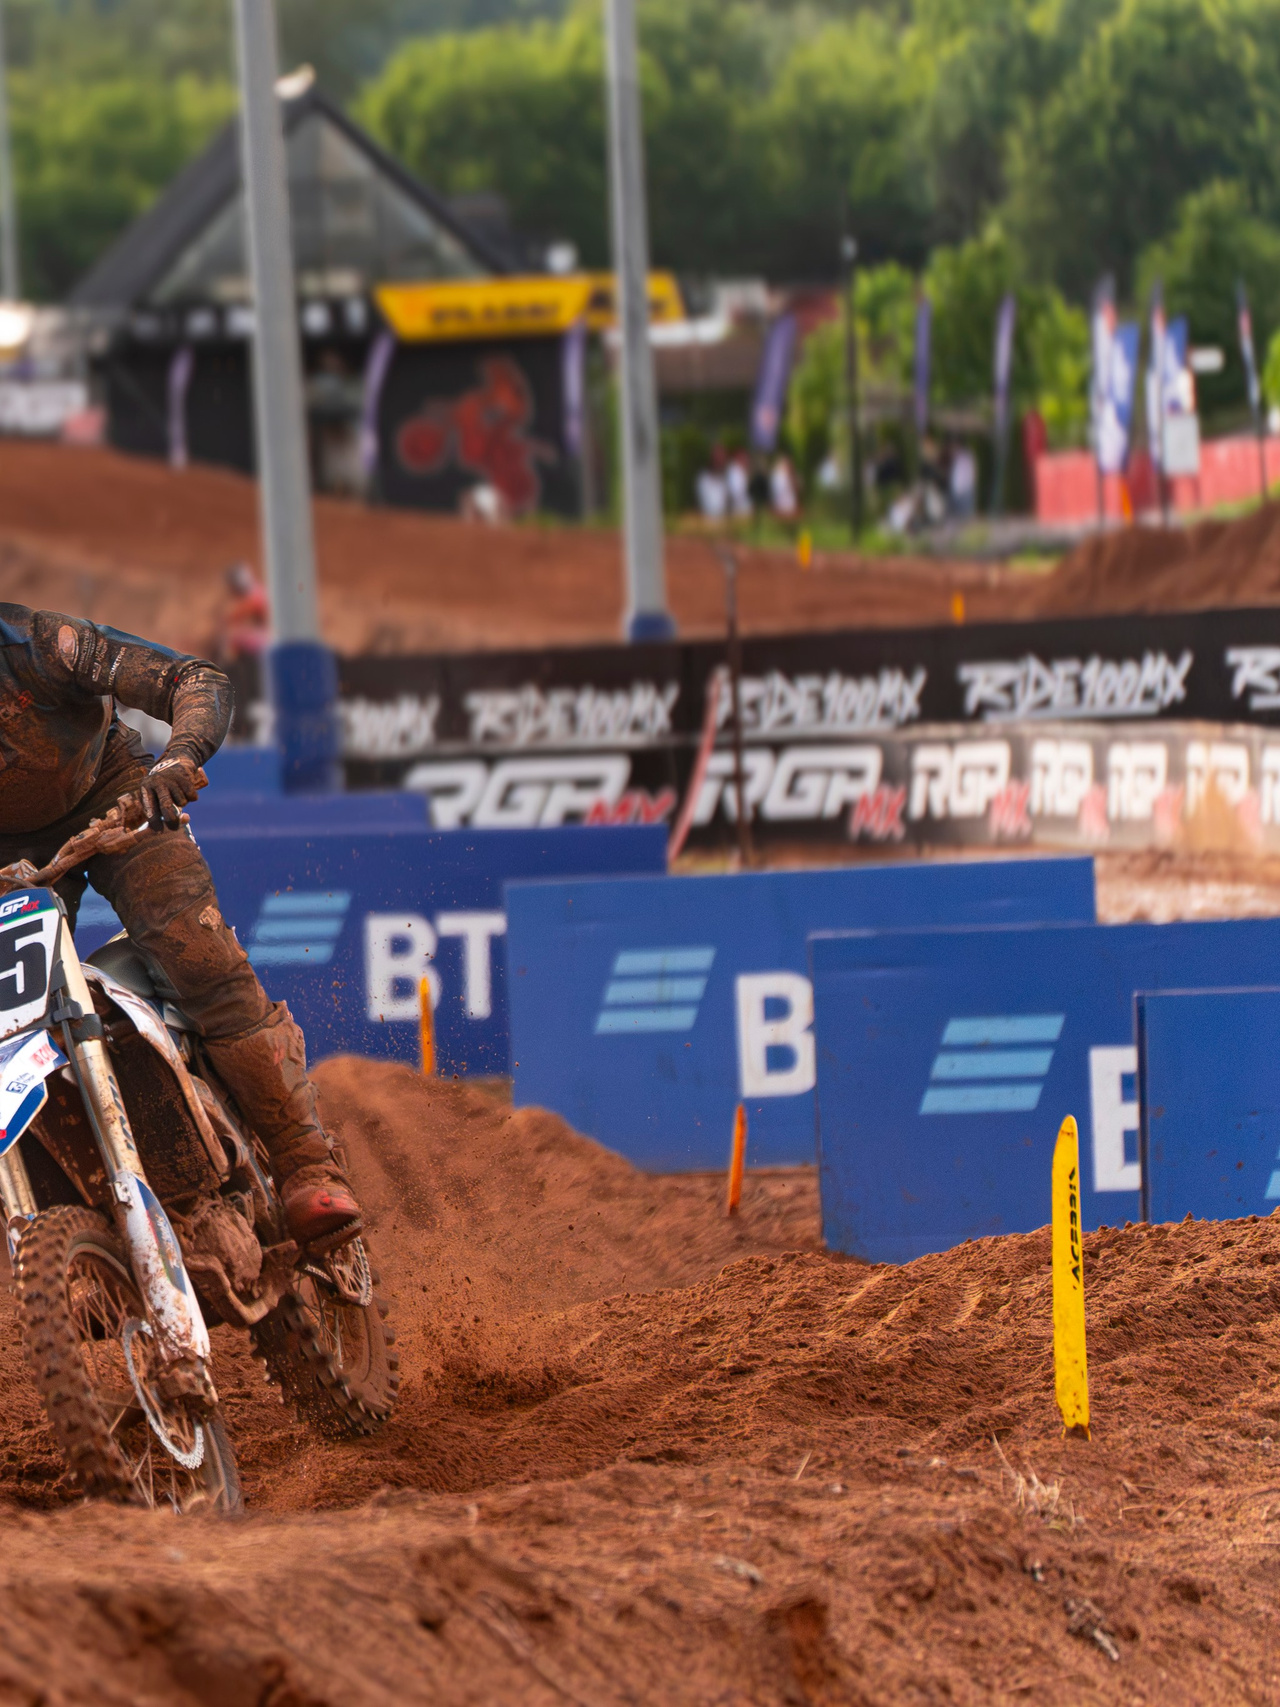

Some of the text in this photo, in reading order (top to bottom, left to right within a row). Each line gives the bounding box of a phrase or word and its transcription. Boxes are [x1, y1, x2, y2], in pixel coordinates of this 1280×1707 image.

[958, 652, 1193, 720] RIDE100MX
[404, 753, 632, 830] RGP
[909, 738, 1011, 821] RGP
[20, 900, 40, 914] MX
